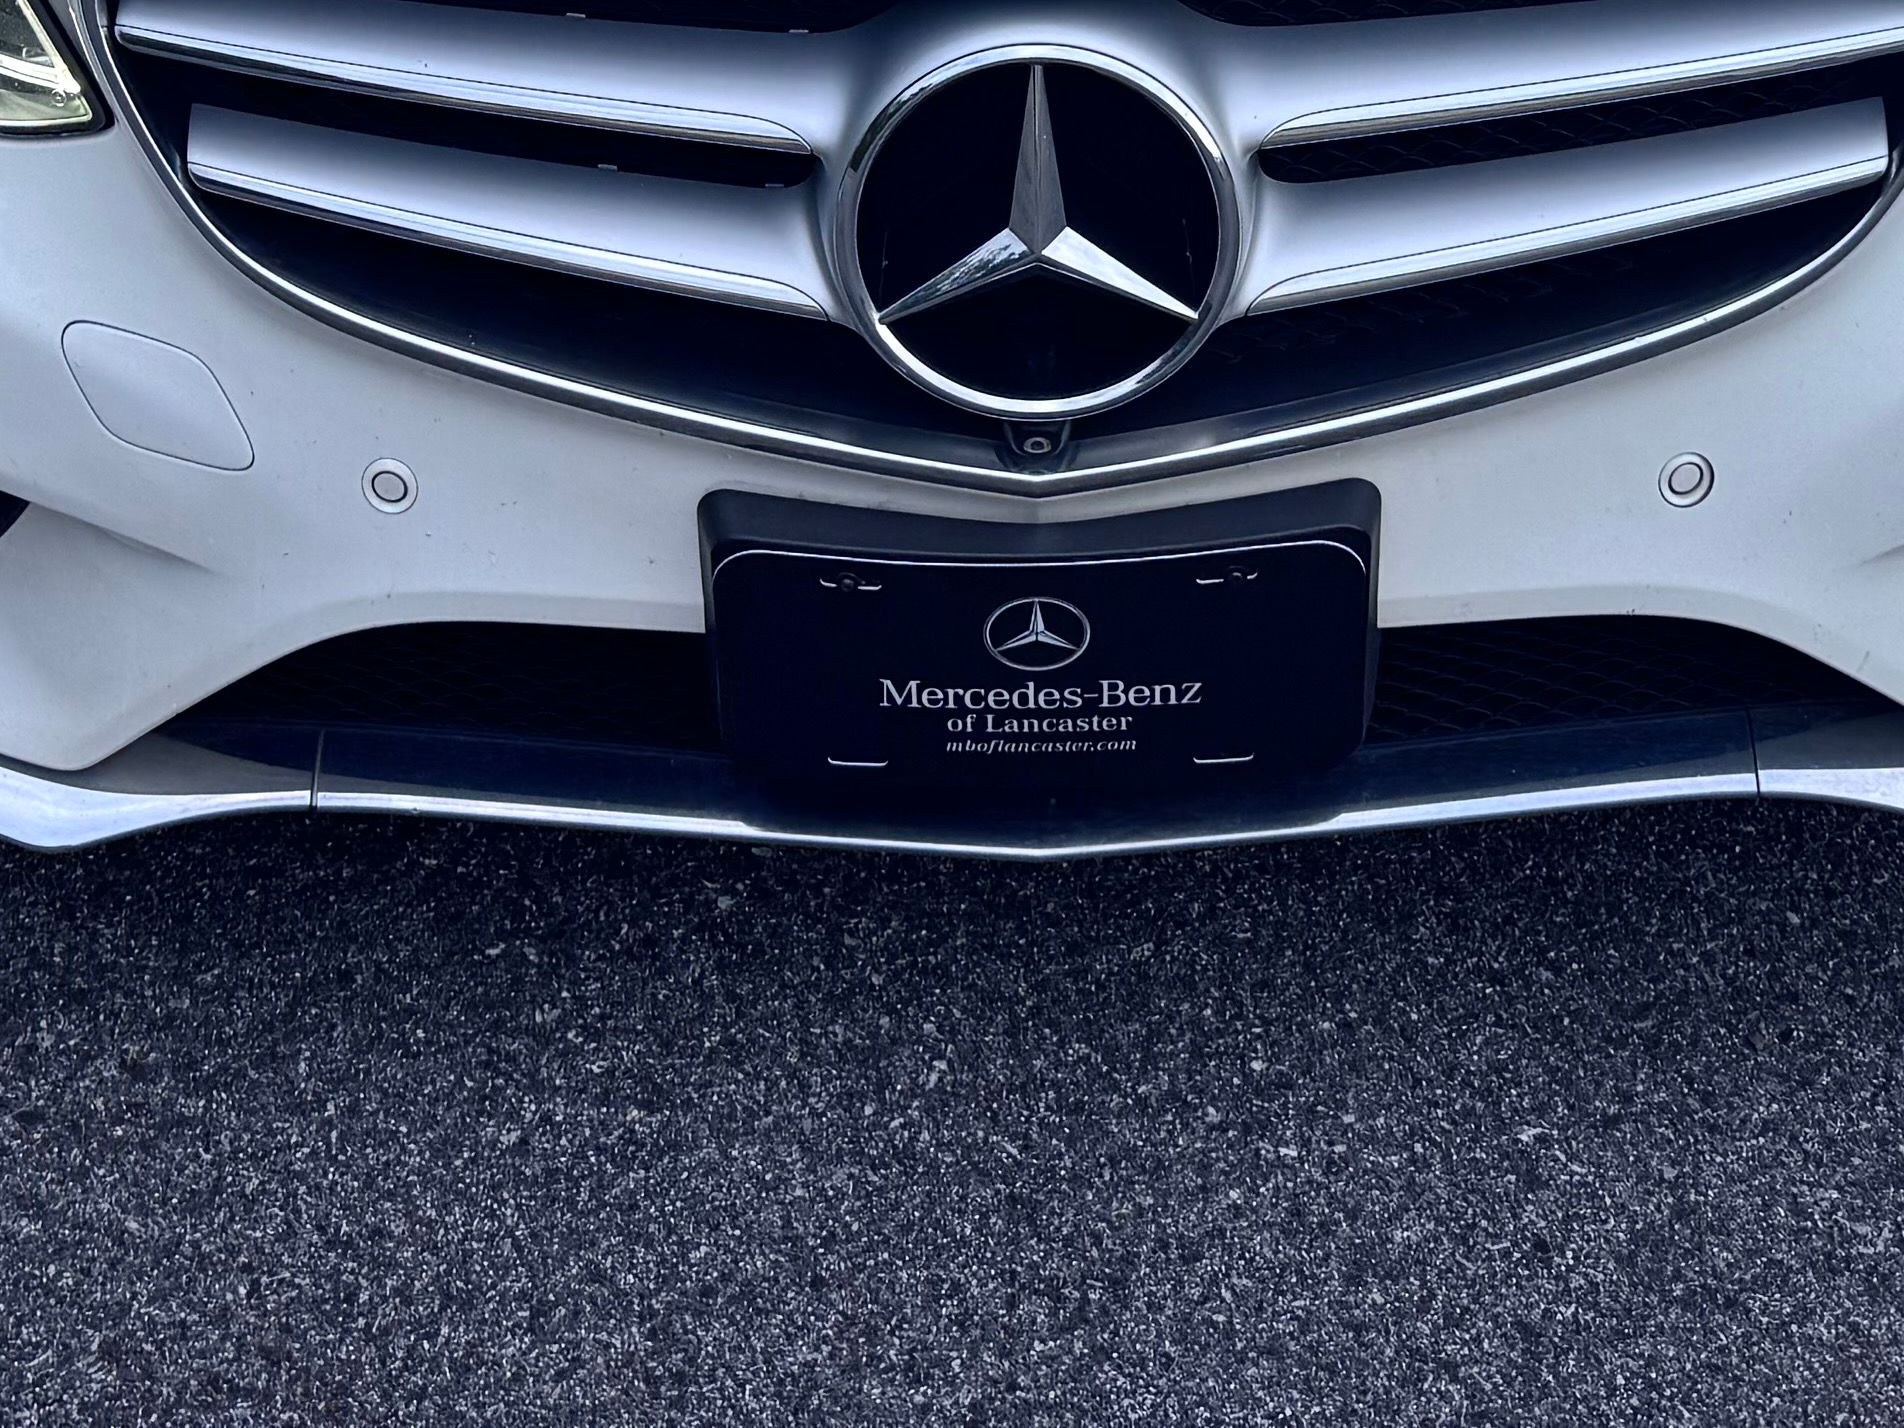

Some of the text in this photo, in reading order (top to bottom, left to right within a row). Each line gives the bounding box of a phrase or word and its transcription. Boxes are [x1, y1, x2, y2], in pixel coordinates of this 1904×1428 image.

[879, 678, 1202, 709] Mercedes-Benz
[947, 714, 1133, 733] of Lancaster
[946, 739, 1137, 754] mboflancaster.com
